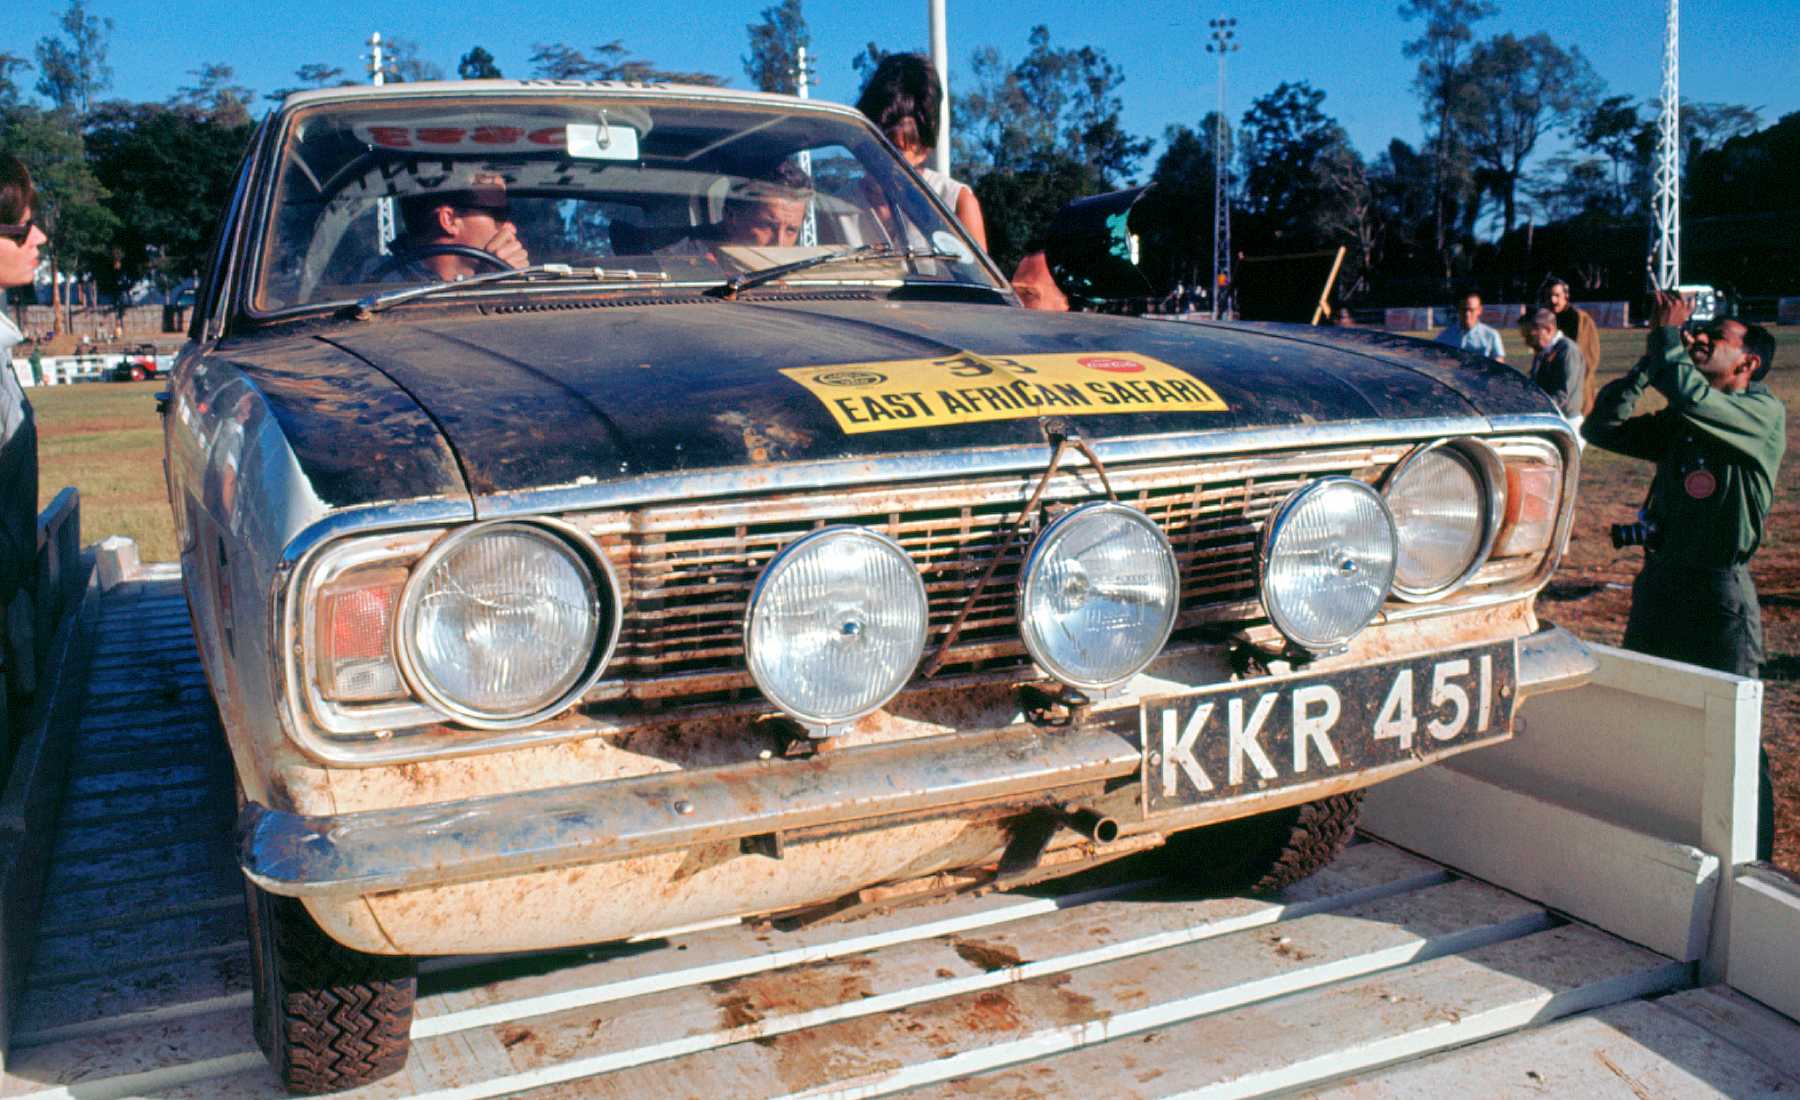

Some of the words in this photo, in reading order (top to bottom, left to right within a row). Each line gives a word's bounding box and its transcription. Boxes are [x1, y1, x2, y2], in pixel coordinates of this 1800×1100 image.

[833, 390, 934, 424] EAST
[937, 380, 1087, 418] AFRICAN
[1087, 379, 1215, 405] SAFARI
[1162, 684, 1342, 798] KKR
[1374, 655, 1493, 750] 451
